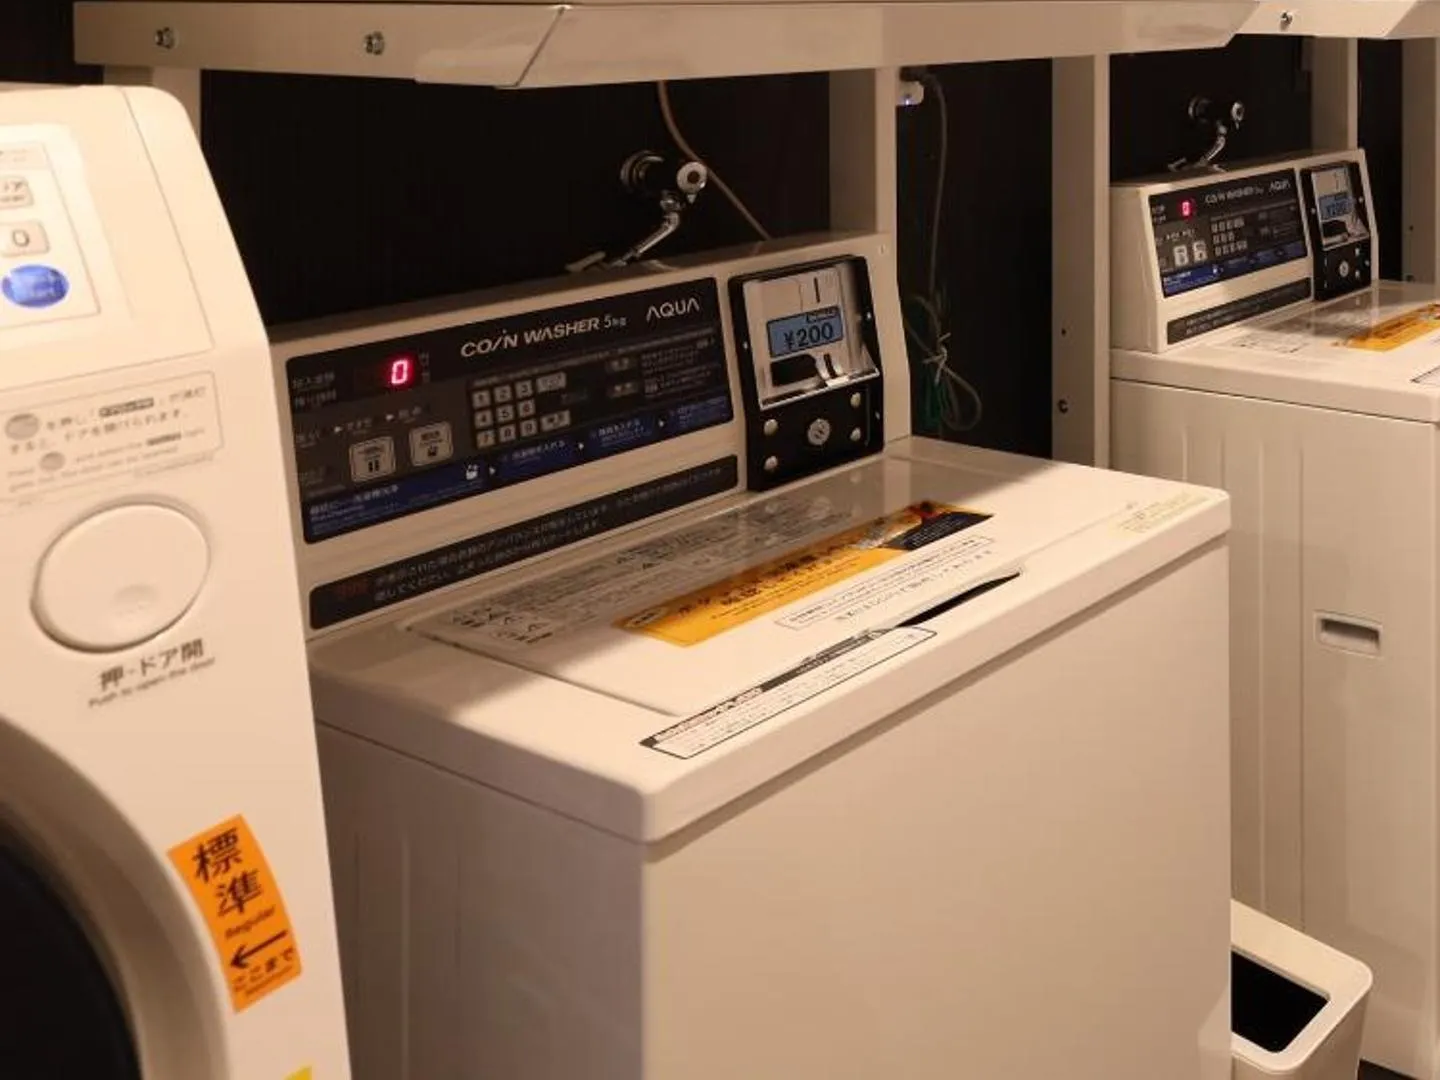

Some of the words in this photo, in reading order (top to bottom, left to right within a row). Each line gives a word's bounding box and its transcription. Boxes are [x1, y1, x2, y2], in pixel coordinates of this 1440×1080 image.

[460, 328, 518, 358] COIN
[524, 317, 600, 345] WASHER
[646, 297, 701, 323] AQUA
[783, 322, 834, 351] ¥200
[390, 359, 409, 385] 0
[191, 826, 263, 917] 標準
